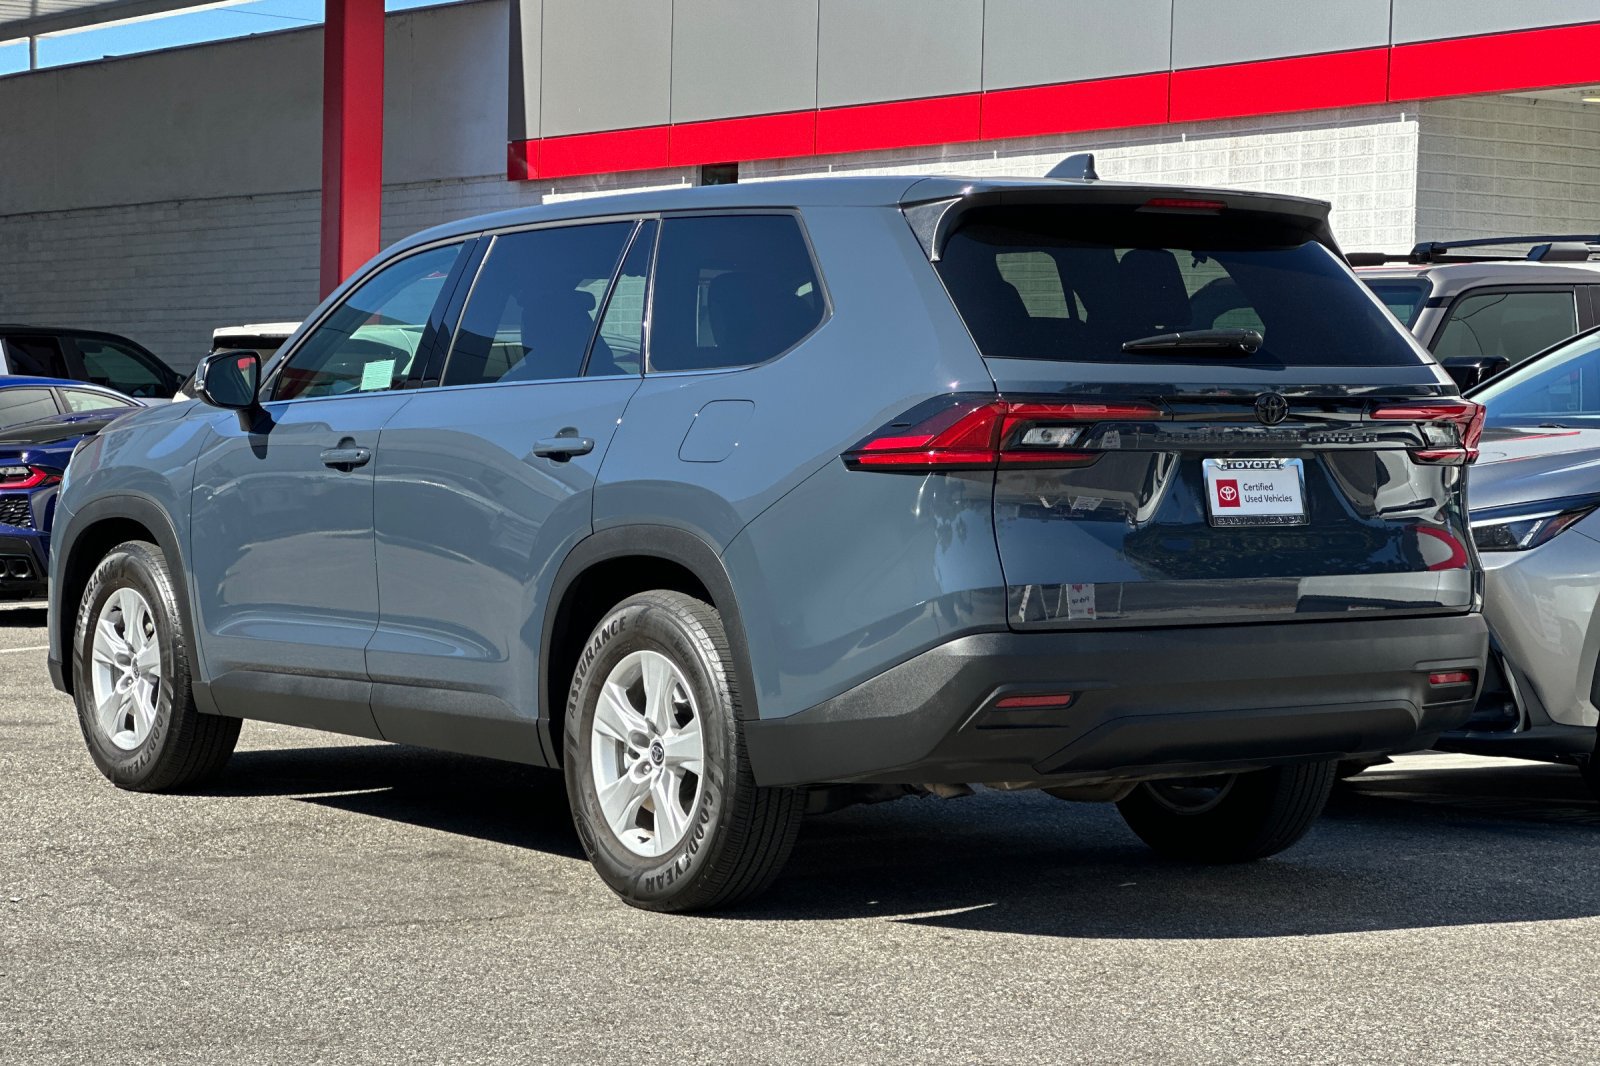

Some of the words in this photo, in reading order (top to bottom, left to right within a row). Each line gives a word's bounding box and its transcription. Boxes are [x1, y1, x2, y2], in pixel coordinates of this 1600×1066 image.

[1229, 461, 1278, 469] TOYOTA
[1243, 483, 1274, 491] Certified
[1244, 495, 1263, 503] Used
[1264, 494, 1293, 503] Vehicles
[568, 616, 627, 720] ASSURANCE
[644, 790, 714, 894] GOODYEAR
